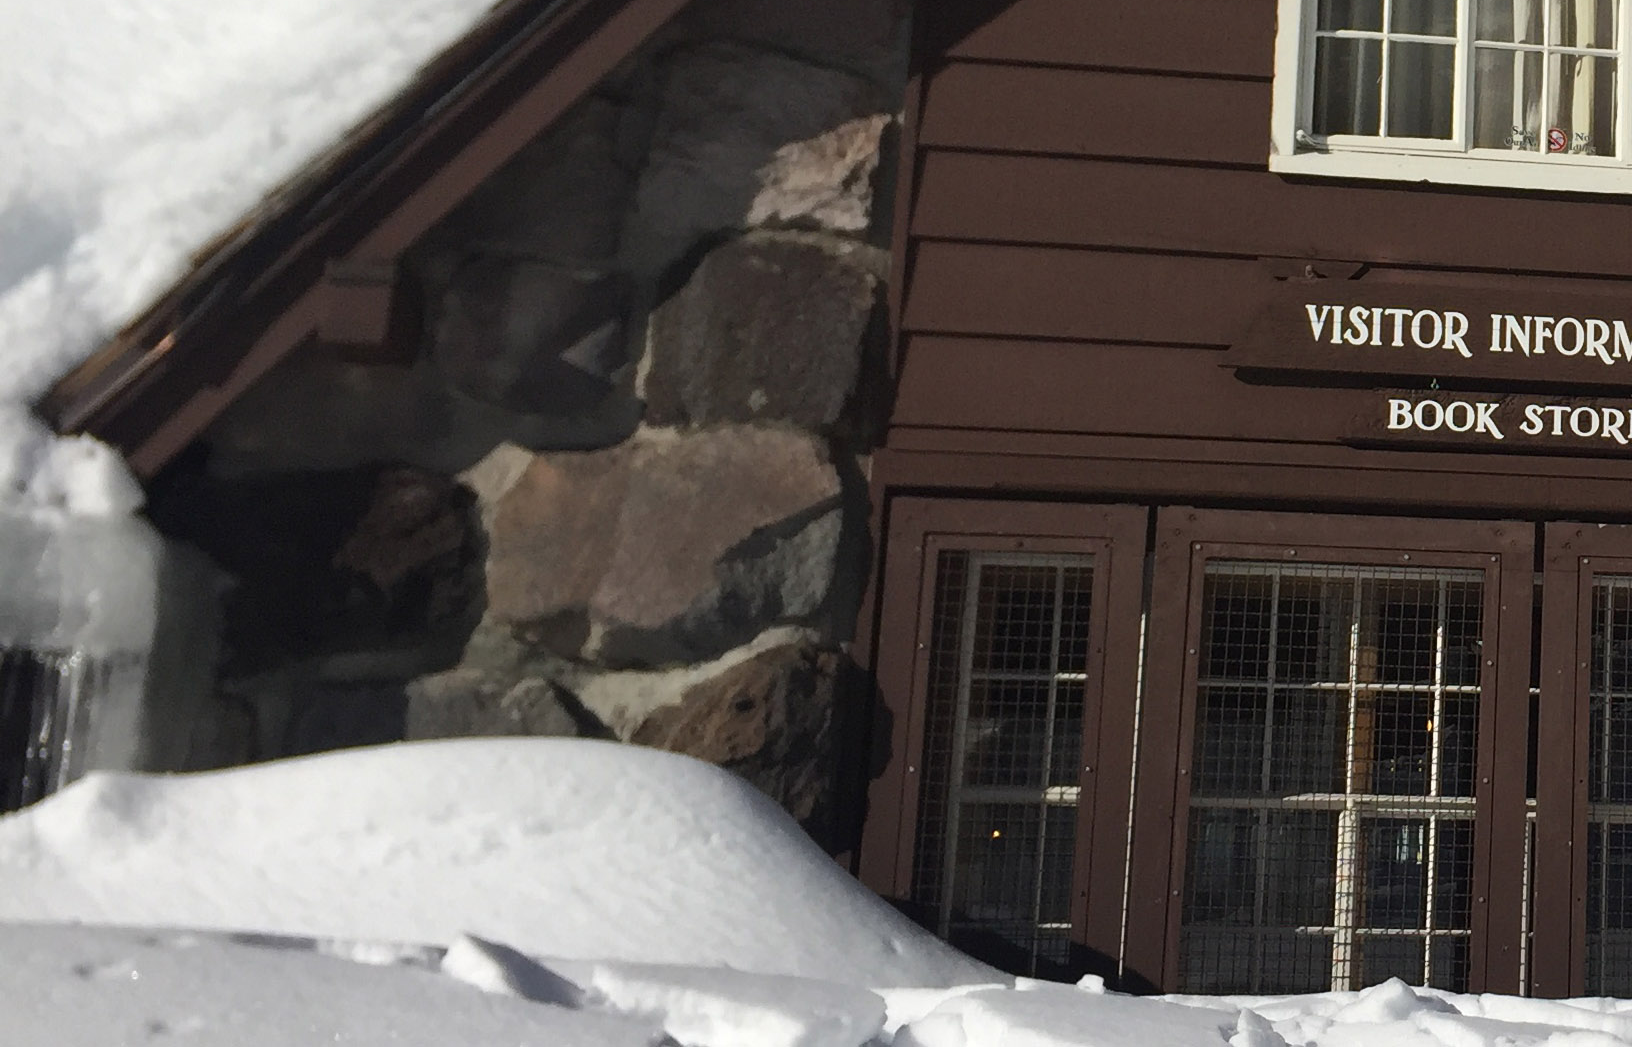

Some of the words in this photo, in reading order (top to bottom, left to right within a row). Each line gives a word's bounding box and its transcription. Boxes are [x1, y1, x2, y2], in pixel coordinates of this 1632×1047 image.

[1575, 132, 1591, 142] No
[1305, 304, 1472, 358] VISITOR
[1387, 399, 1505, 440] BOOK
